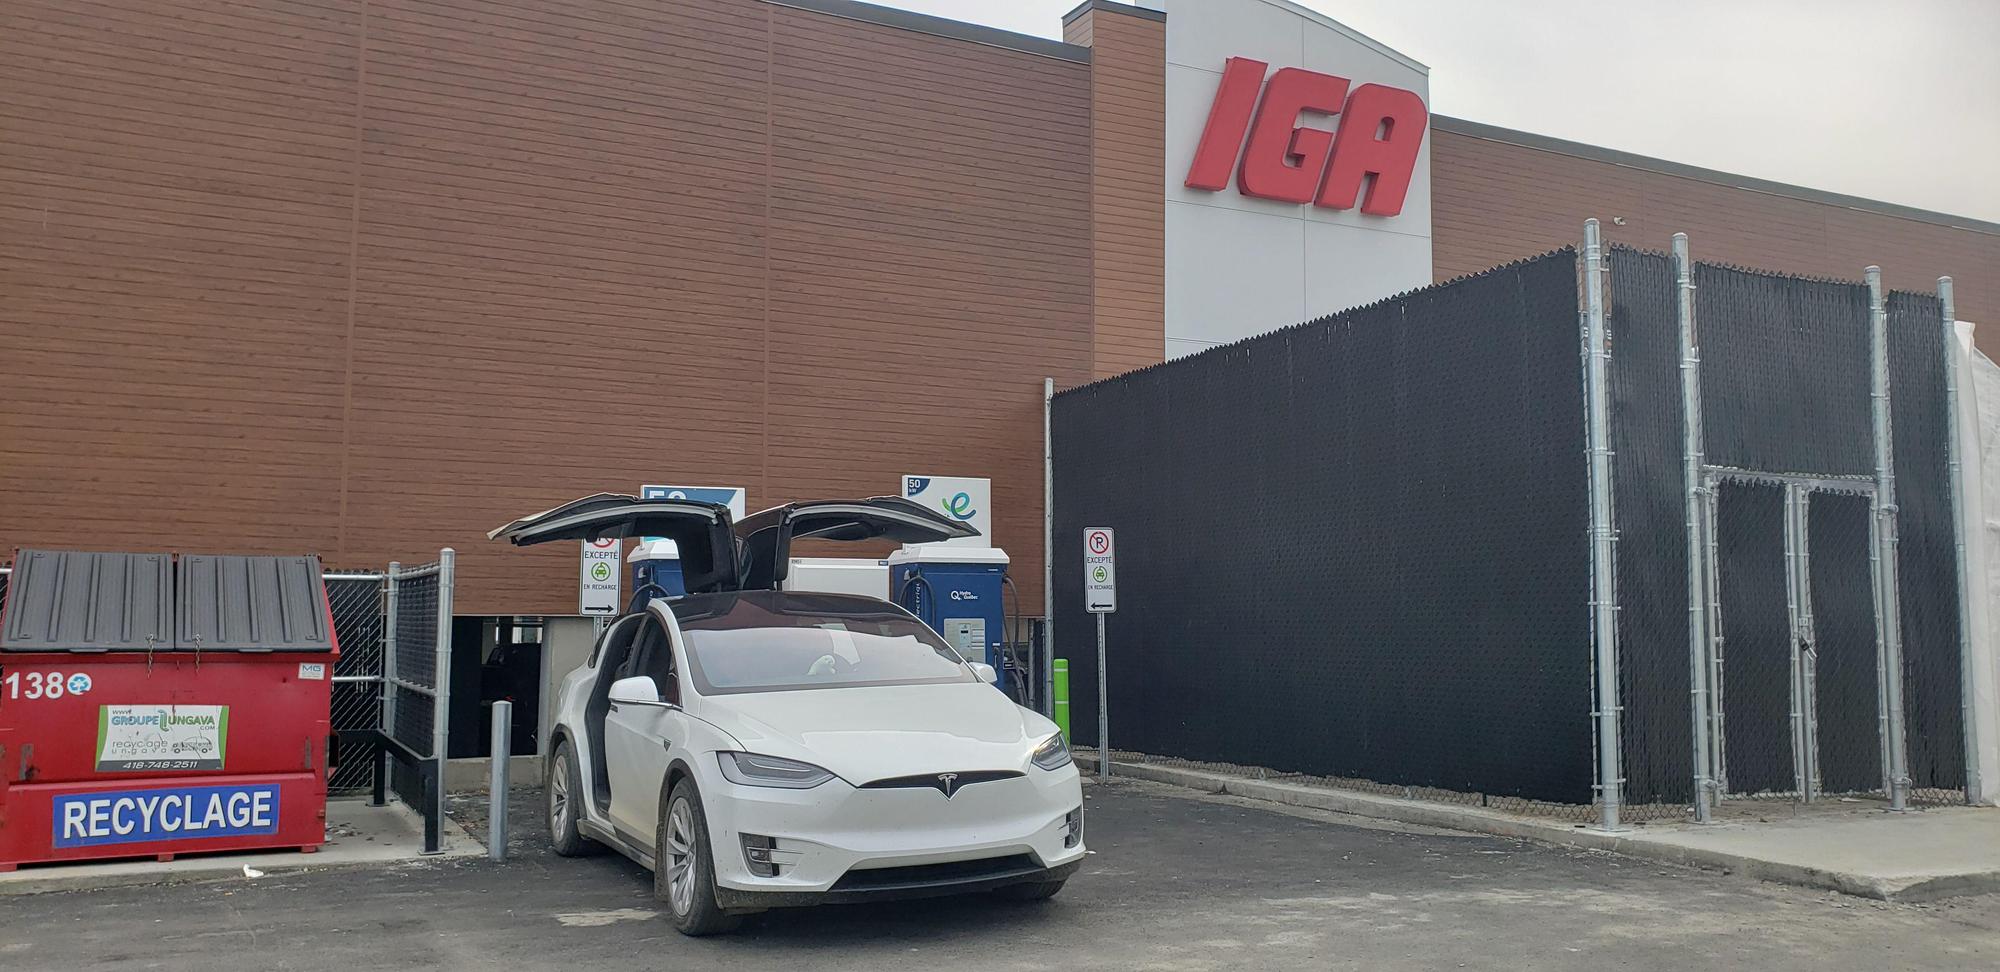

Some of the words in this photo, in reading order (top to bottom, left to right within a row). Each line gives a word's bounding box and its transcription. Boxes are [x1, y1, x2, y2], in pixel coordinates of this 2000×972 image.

[1184, 56, 1428, 217] IGA
[908, 479, 921, 488] 50
[584, 550, 619, 560] EXCEPTÉ
[6, 672, 64, 699] 138
[111, 716, 159, 726] GROUPE
[168, 716, 215, 725] UNGAVA
[63, 791, 272, 839] RECYCLAGE
